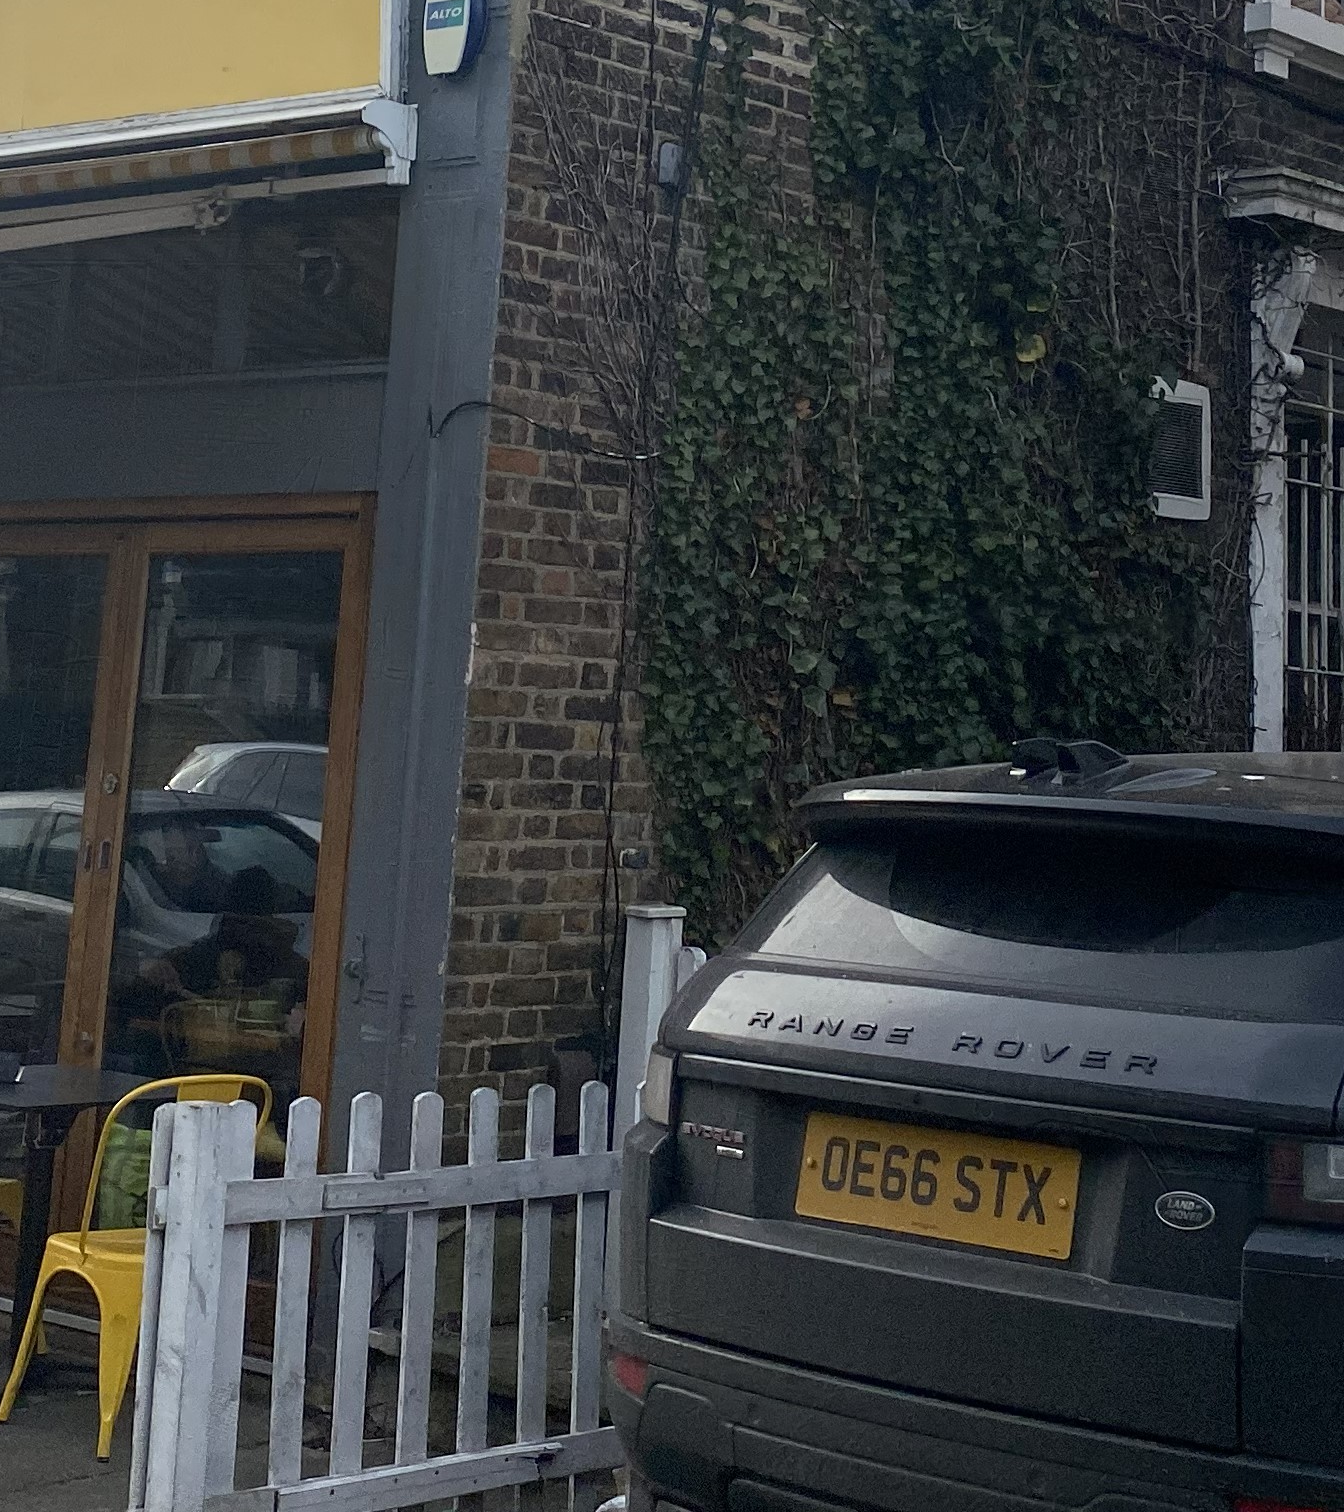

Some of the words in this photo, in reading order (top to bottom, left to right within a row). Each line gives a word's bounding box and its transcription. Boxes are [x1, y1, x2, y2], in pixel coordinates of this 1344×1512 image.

[429, 6, 463, 20] ALTO
[748, 1009, 915, 1046] RANGE
[951, 1031, 1159, 1075] ROVER
[821, 1135, 942, 1207] OE66
[953, 1155, 1052, 1226] STX
